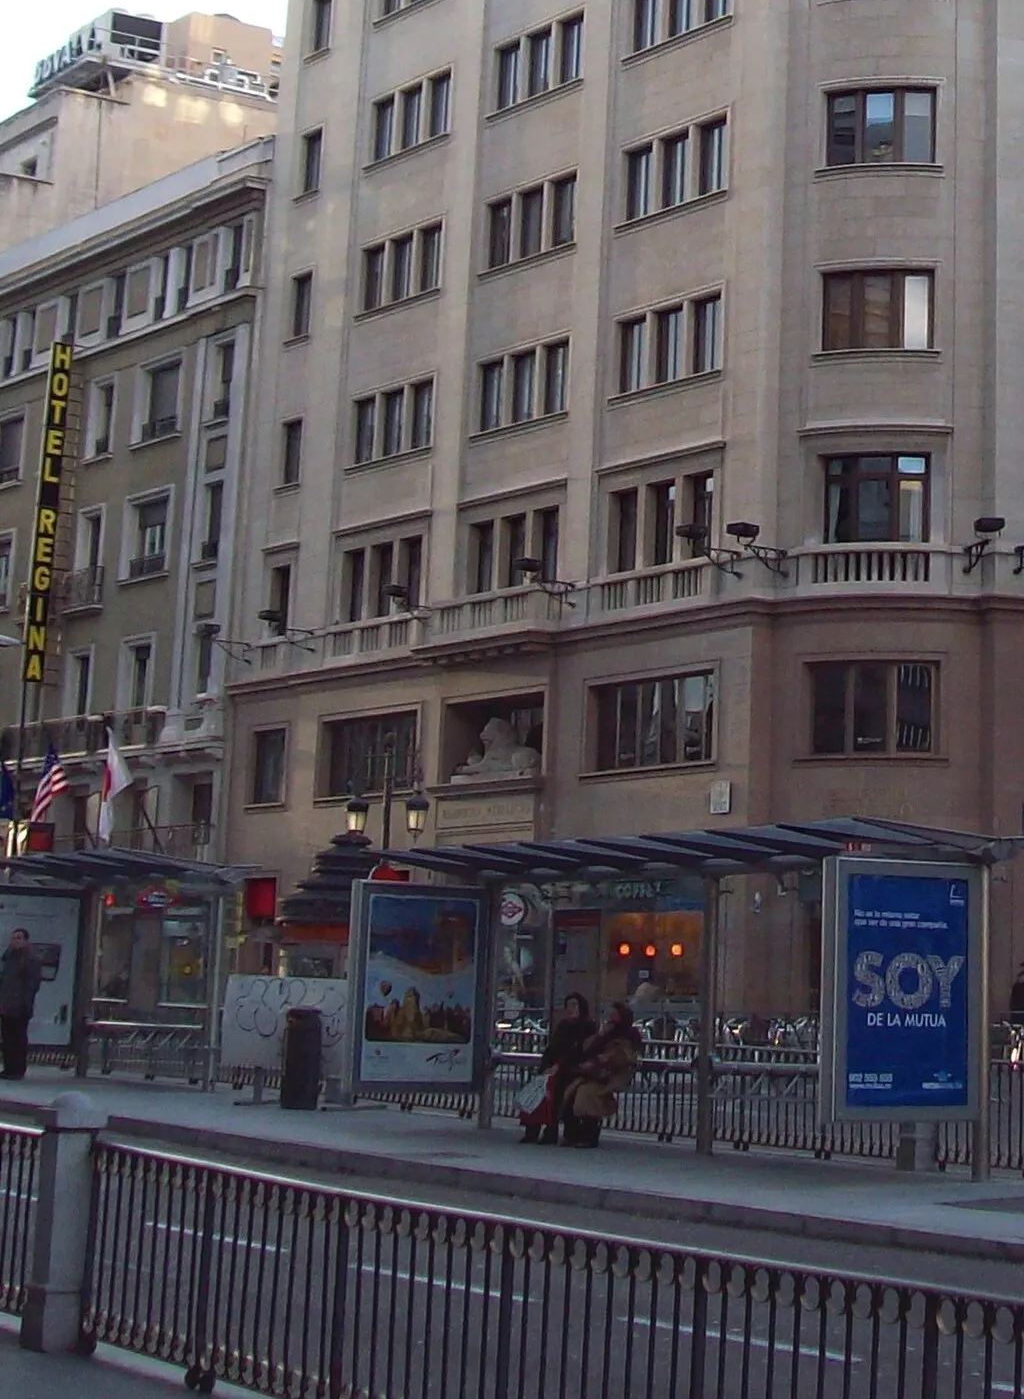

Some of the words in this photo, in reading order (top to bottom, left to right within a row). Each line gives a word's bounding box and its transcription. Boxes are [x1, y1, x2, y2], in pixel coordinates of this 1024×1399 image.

[43, 344, 71, 483] HOTEL
[26, 508, 57, 680] REGINA
[852, 950, 966, 1010] SOY
[867, 1012, 884, 1027] DE
[886, 1012, 901, 1027] LA
[904, 1013, 947, 1028] MUTUA
